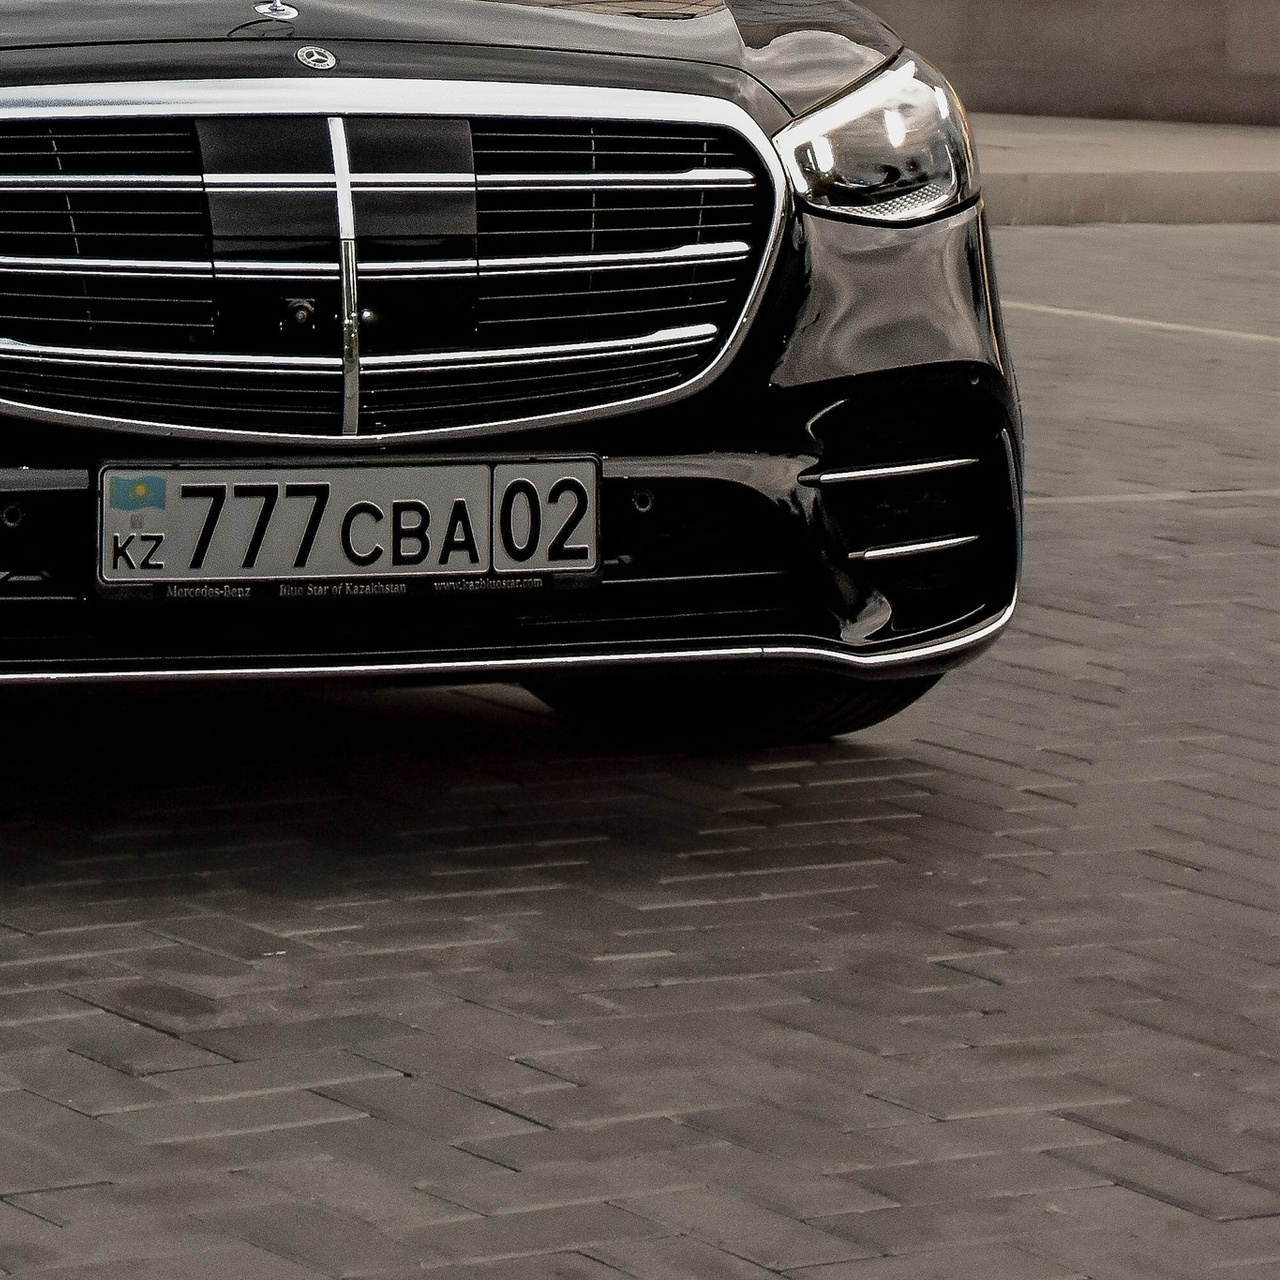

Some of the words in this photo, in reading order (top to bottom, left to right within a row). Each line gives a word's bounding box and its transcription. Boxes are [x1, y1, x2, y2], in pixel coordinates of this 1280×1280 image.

[499, 477, 589, 562] 02
[112, 532, 165, 570] KZ
[166, 585, 251, 598] Mercedes-Benz
[279, 583, 304, 596] Blue
[306, 583, 330, 596] Star
[332, 582, 344, 595] of
[345, 581, 407, 595] Kazakhstan
[433, 577, 544, 591] www.kazbluestar.com
